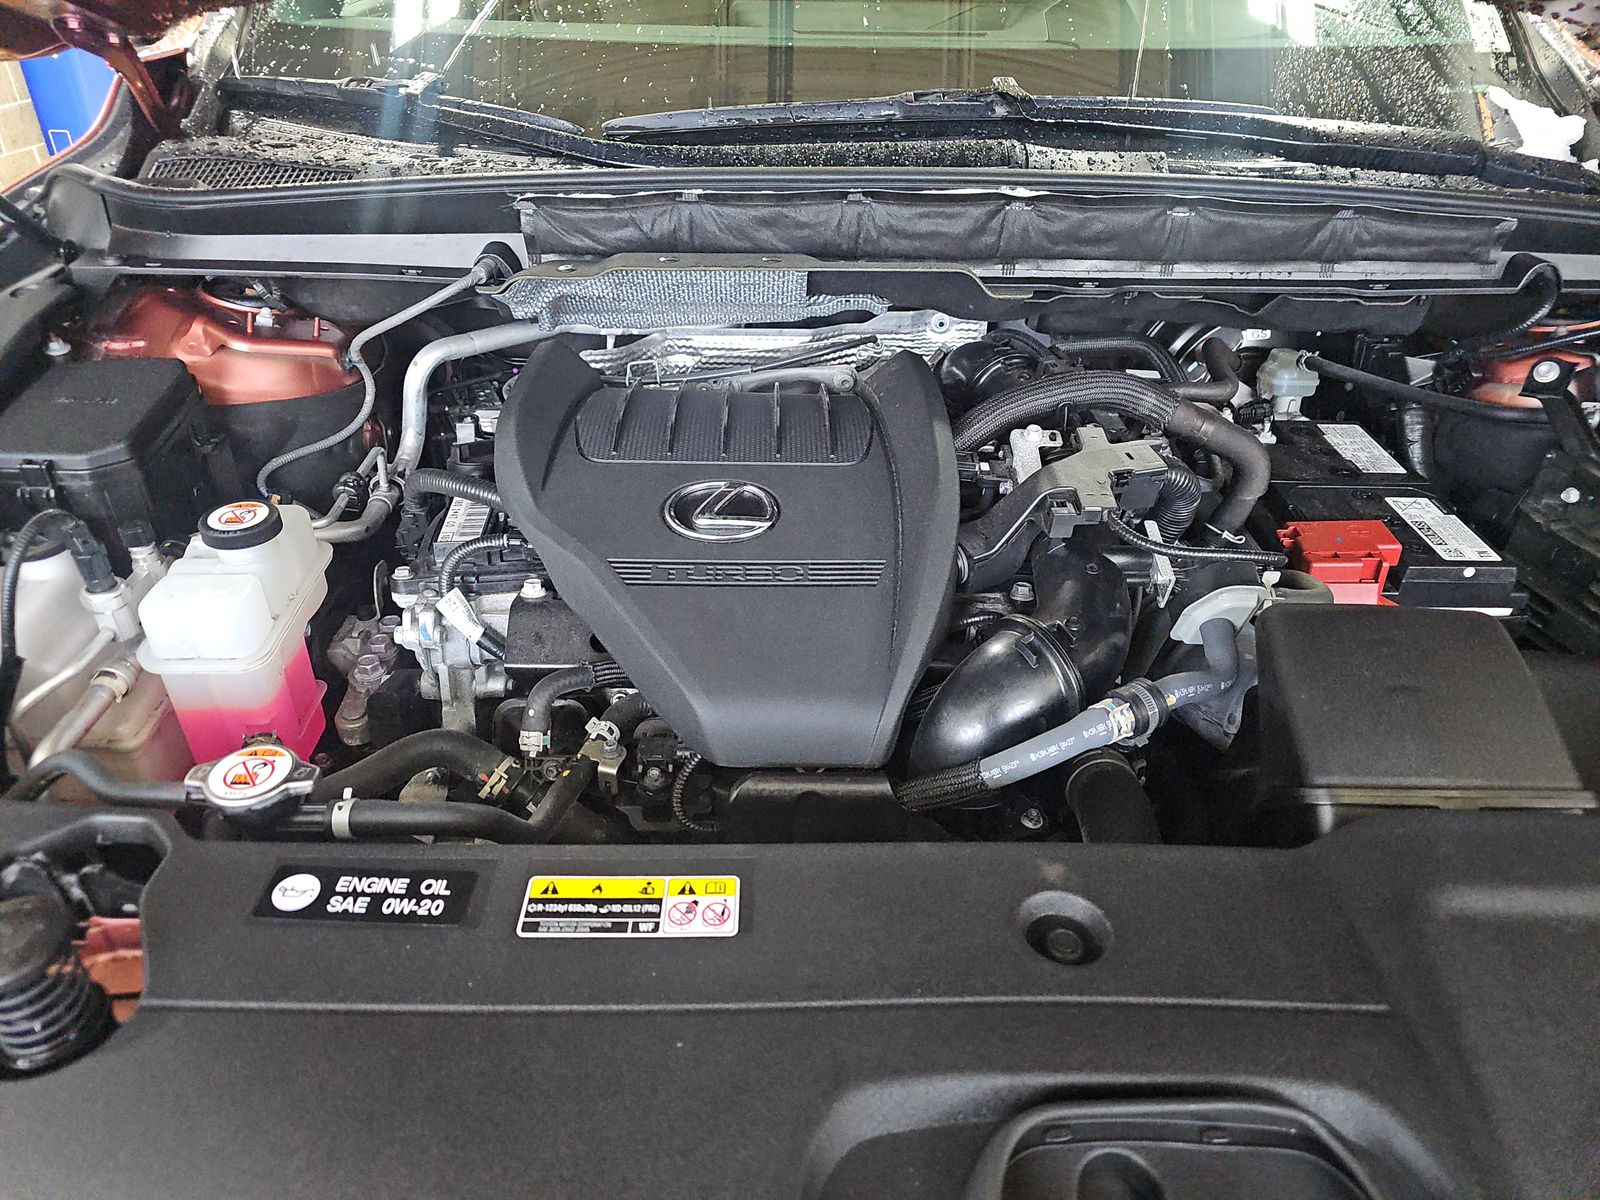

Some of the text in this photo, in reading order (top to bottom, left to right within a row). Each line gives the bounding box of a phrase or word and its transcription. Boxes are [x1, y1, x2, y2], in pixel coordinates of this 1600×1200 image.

[656, 564, 804, 581] TURBO
[335, 876, 451, 896] ENGINE OIL
[326, 896, 445, 917] SAE 0W-20
